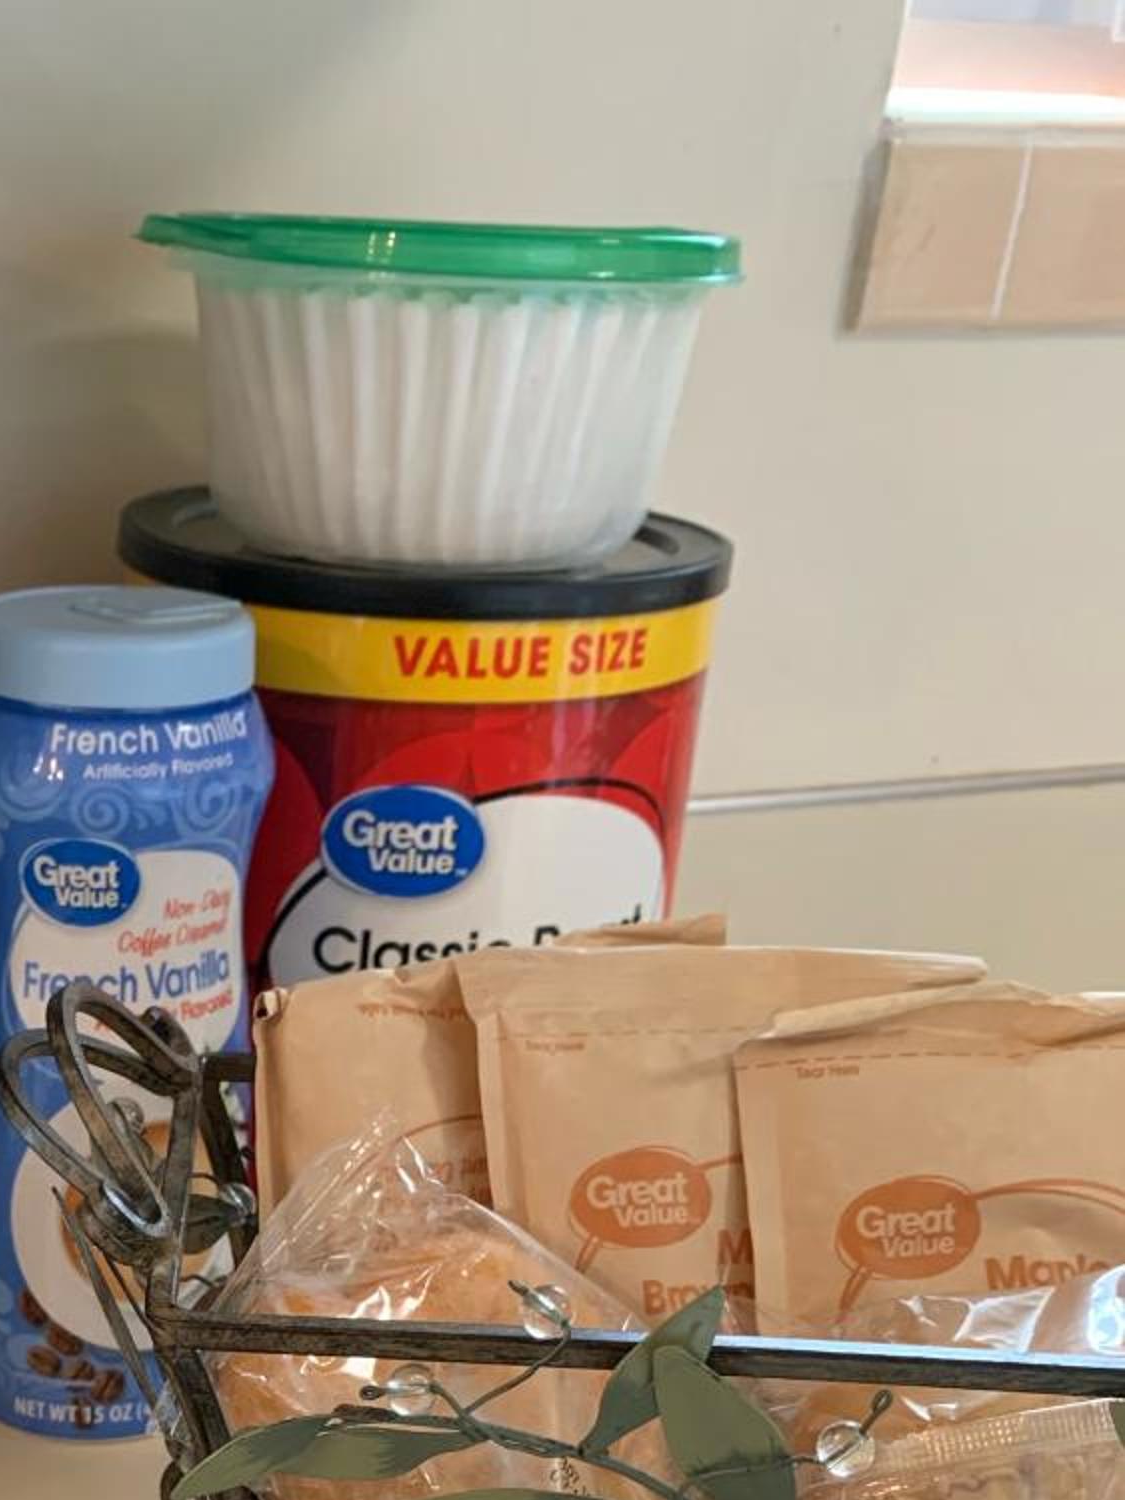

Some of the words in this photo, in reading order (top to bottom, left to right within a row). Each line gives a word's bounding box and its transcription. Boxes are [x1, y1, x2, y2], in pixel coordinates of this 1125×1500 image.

[393, 635, 552, 679] VALUE
[569, 628, 648, 676] SIZE
[50, 721, 159, 756] French
[165, 710, 247, 751] Vanilla
[82, 761, 167, 780] Artificially
[171, 752, 234, 776] Flavored
[342, 809, 459, 852] Great
[32, 856, 120, 889] Great
[367, 847, 455, 876] Value
[53, 885, 119, 910] Value
[312, 925, 515, 975] Class
[145, 949, 230, 1000] Vanilla
[585, 1171, 689, 1211] Great
[613, 1201, 690, 1229] Value
[855, 1203, 956, 1239] Great
[879, 1234, 956, 1259] Value
[13, 1396, 46, 1418] NET
[49, 1402, 76, 1423] WT
[80, 1403, 106, 1423] 15
[108, 1402, 133, 1422] OZ
